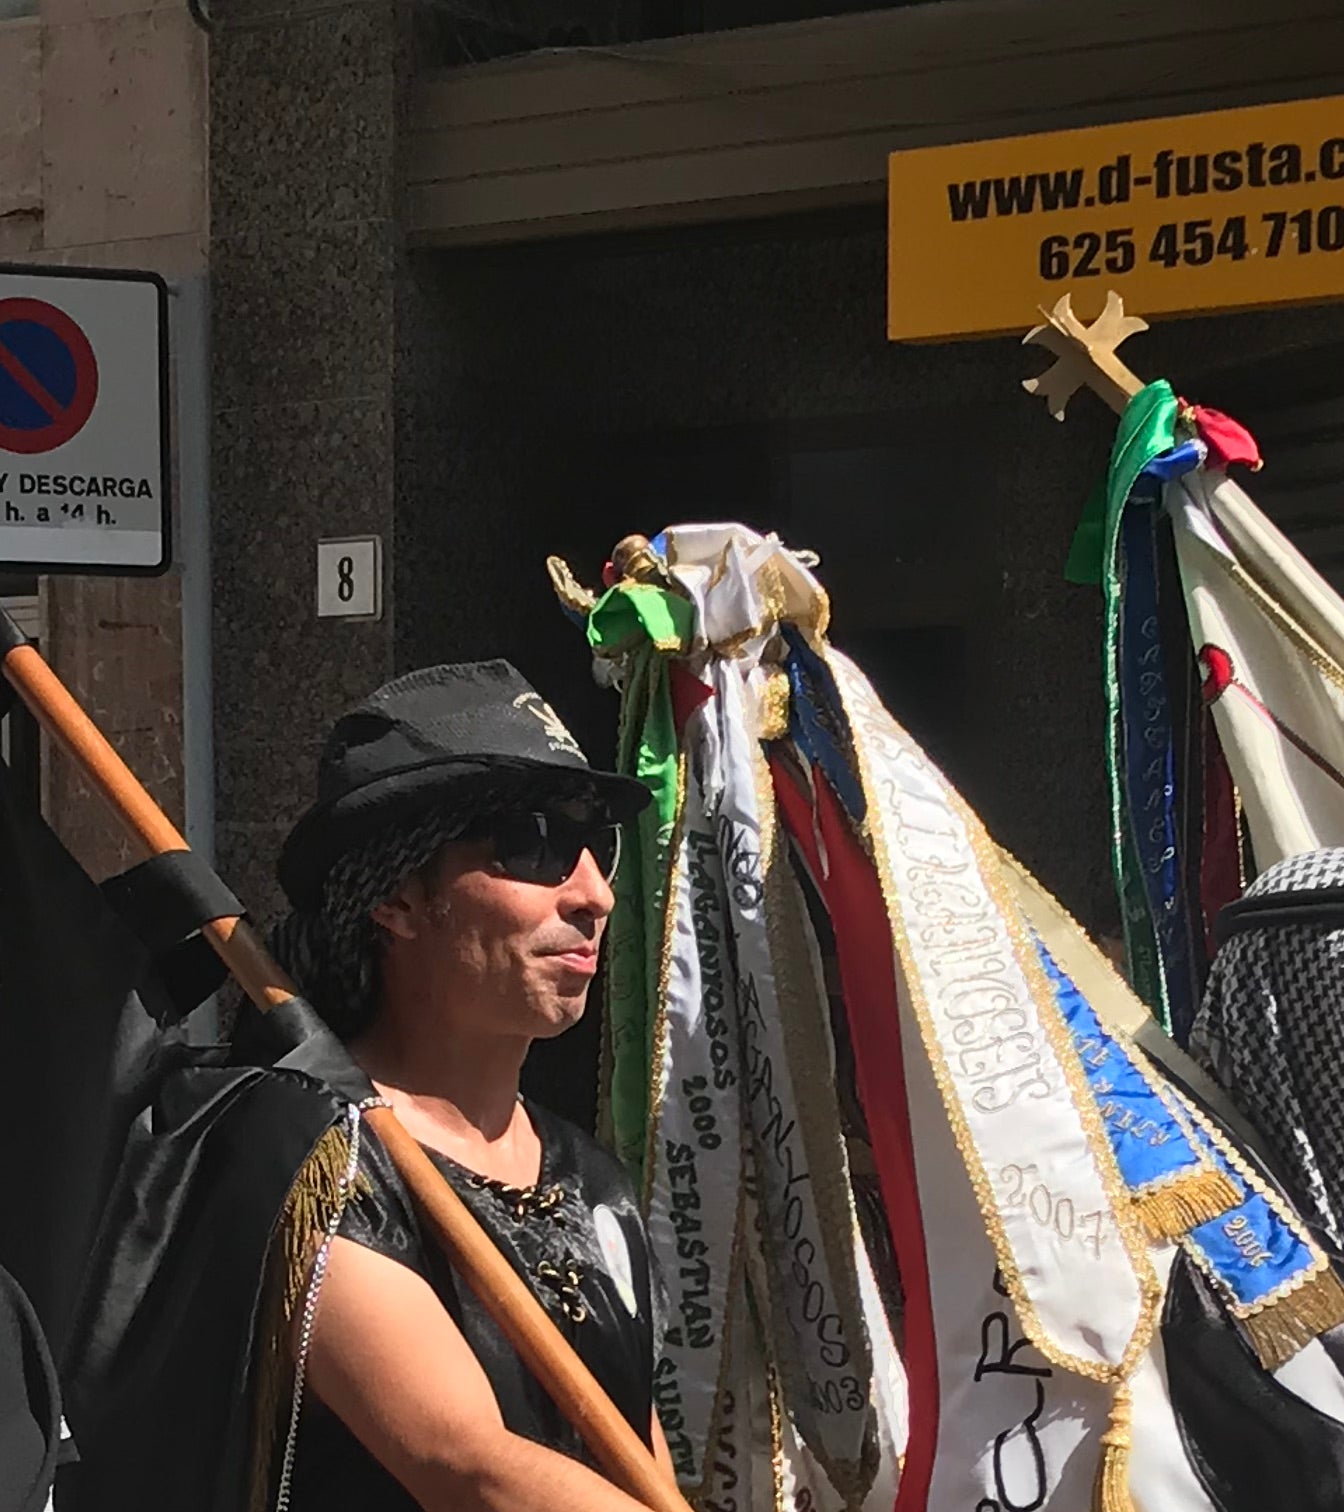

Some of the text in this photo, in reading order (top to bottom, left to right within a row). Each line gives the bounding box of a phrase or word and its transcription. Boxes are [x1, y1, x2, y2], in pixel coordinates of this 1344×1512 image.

[1038, 228, 1135, 281] 625
[1148, 222, 1248, 271] 454
[20, 473, 154, 499] DESCARGA
[6, 501, 25, 522] h.
[36, 505, 50, 523] a
[97, 504, 117, 526] h.
[336, 556, 355, 602] 8
[681, 1074, 722, 1151] 2000
[665, 1139, 714, 1350] SEBASTIAN
